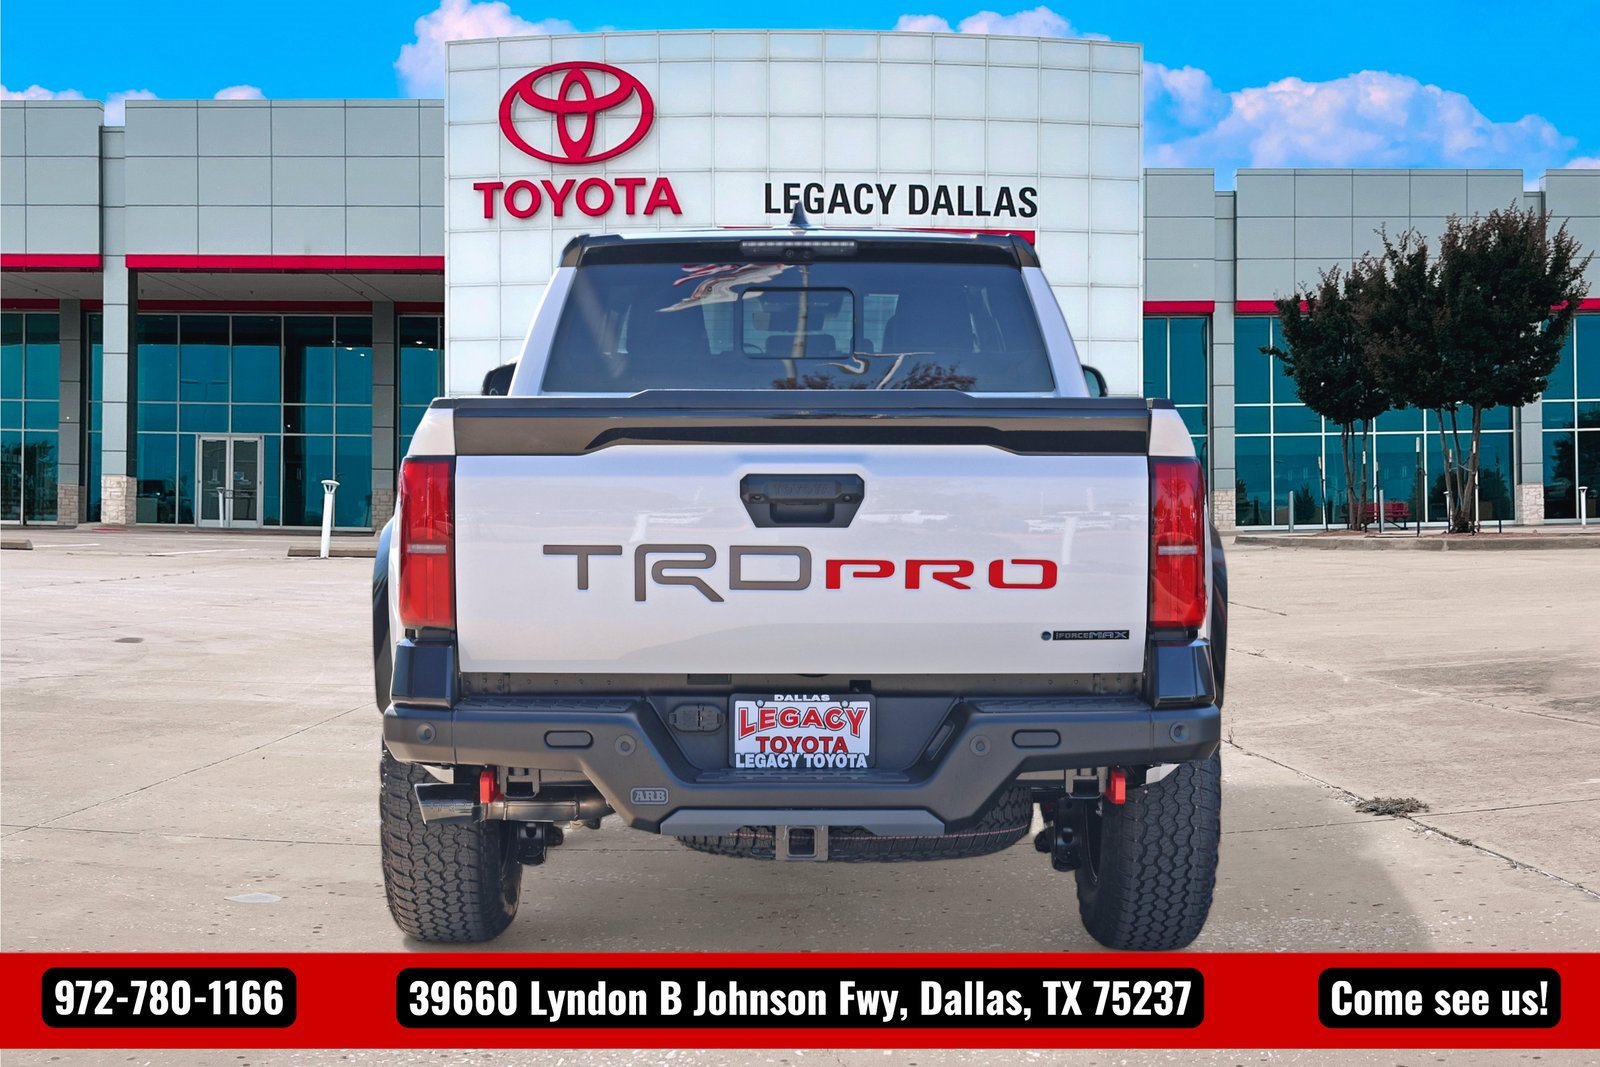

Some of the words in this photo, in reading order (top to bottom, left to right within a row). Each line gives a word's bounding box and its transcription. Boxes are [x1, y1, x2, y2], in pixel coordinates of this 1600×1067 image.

[473, 177, 682, 219] TOYOTA
[764, 183, 897, 215] LEGACY
[908, 184, 1038, 218] DALLAS
[543, 544, 812, 602] TRD
[825, 559, 1058, 590] PRO
[774, 694, 830, 702] DALLAS
[739, 706, 868, 740] LEGACY
[755, 736, 849, 753] TOYOTA
[735, 753, 800, 768] LEGACY
[803, 753, 868, 768] TOYOTA
[634, 790, 666, 802] ARB
